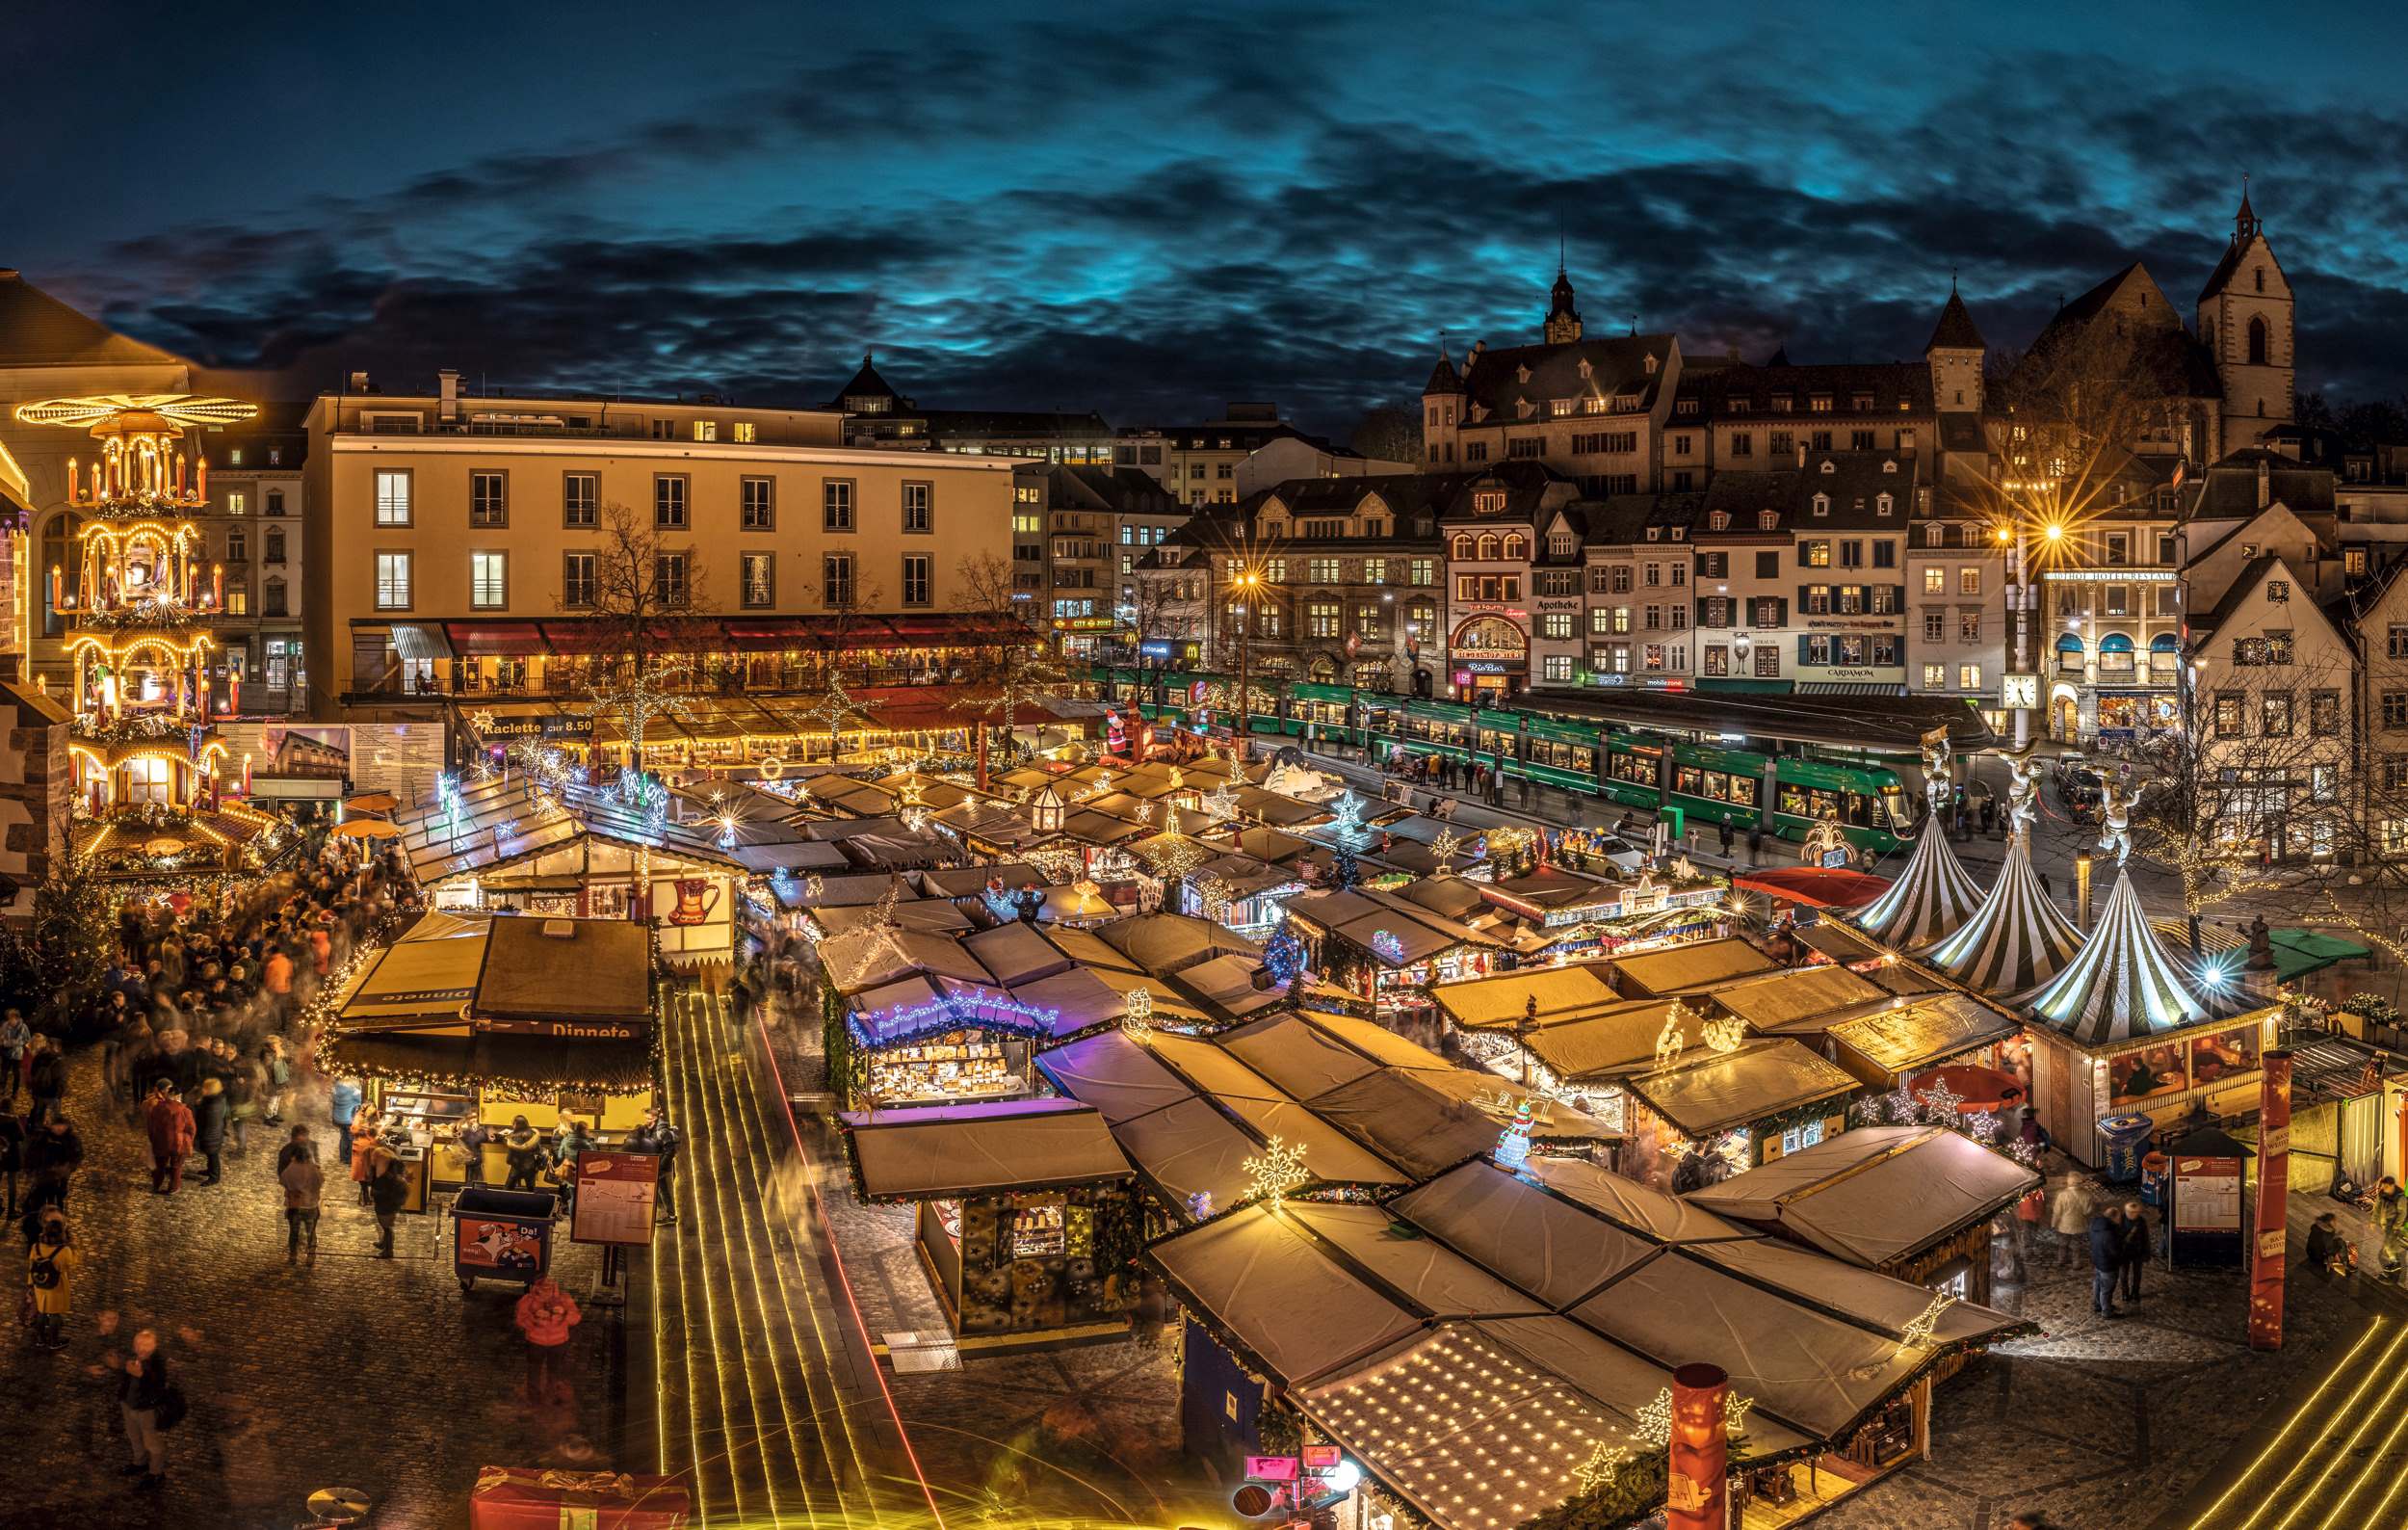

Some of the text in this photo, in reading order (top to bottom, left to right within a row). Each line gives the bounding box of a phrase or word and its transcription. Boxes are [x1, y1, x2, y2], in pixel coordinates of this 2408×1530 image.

[1537, 600, 1578, 610] Apotheke
[1468, 663, 1506, 673] Rio Bar
[1827, 669, 1875, 677] CARDAMOM
[483, 723, 541, 735] Raclette
[566, 721, 592, 731] 8.50
[552, 1022, 631, 1038] Dinnete
[520, 1227, 538, 1236] Da!
